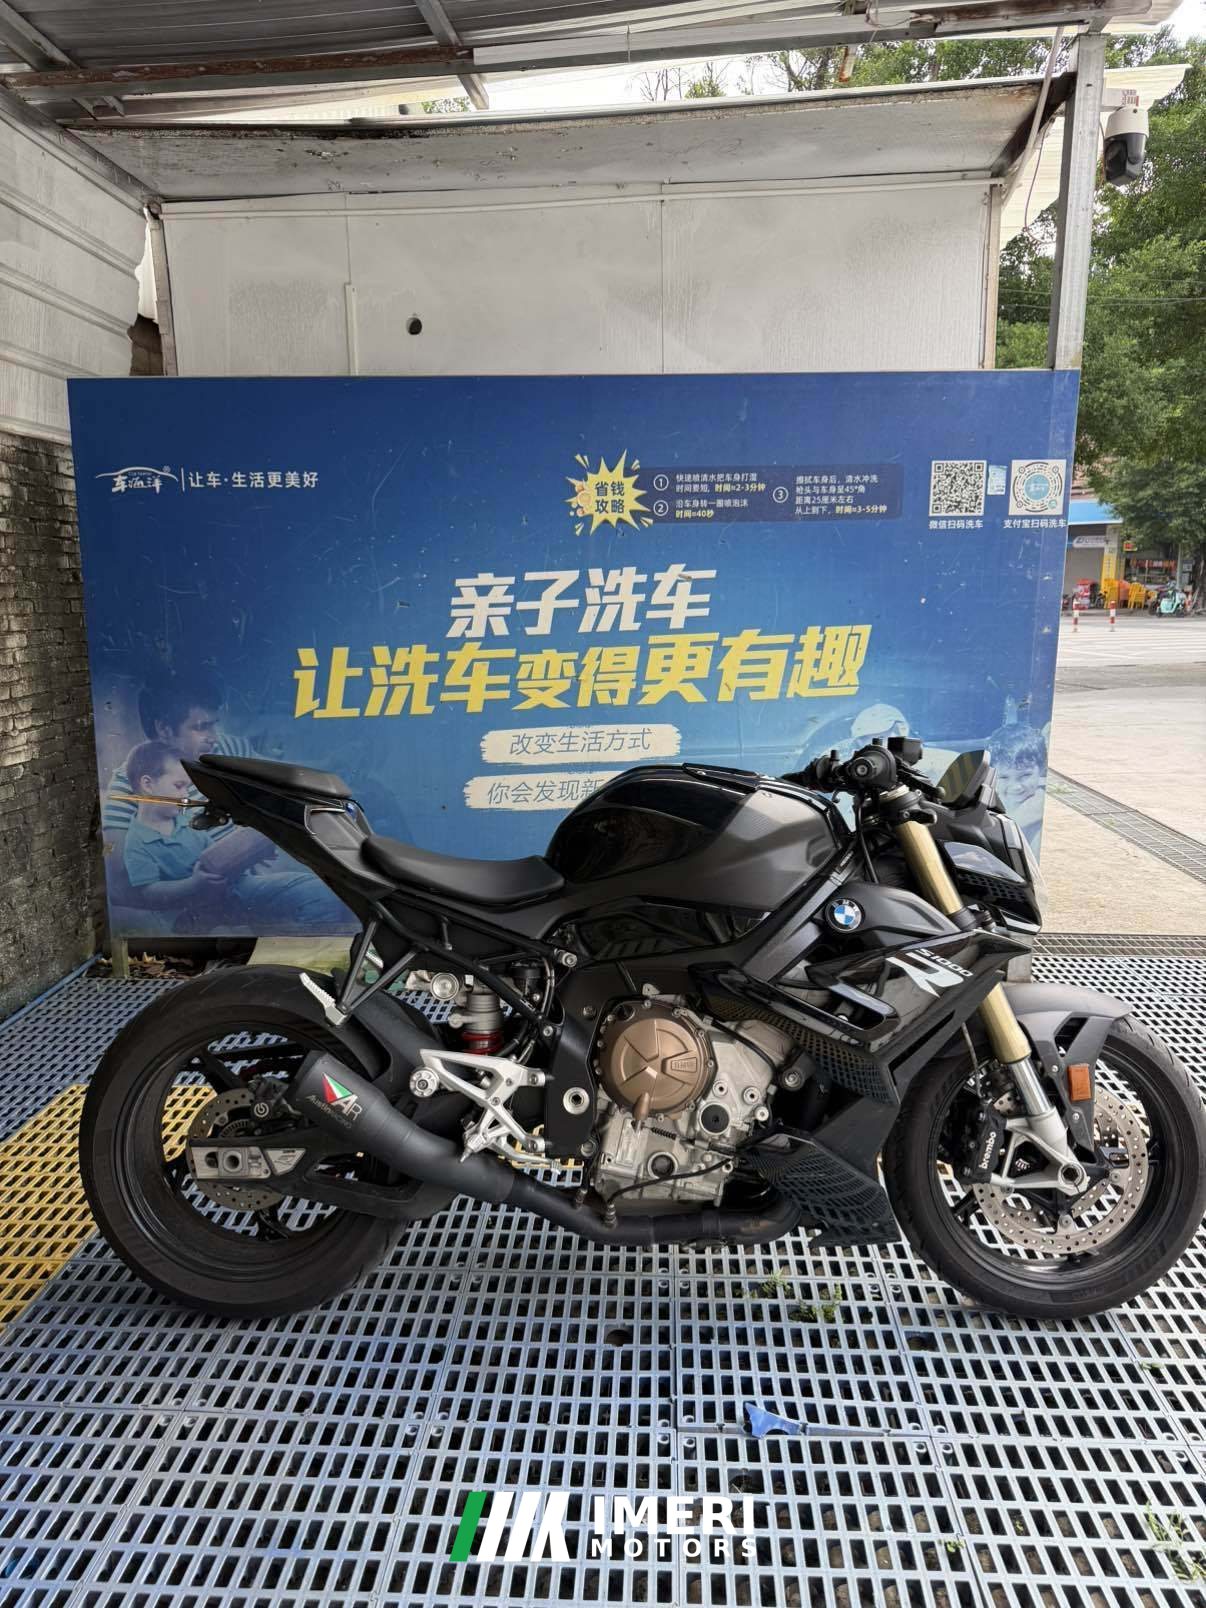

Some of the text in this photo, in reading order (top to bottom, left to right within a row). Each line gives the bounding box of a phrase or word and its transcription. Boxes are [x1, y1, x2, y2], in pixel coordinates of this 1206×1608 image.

[188, 471, 319, 488] 让车·生活更美好
[595, 481, 625, 497] 省钱
[595, 499, 625, 514] 攻略
[676, 509, 714, 519] 时间=40秒
[929, 520, 983, 529] 微信扫码洗车
[1003, 519, 1067, 529] 支付宝扫码洗车
[446, 563, 717, 638] 亲子洗车
[293, 624, 872, 719] 让洗车变得更有趣
[509, 728, 653, 755] 改变生活方式
[914, 948, 973, 977] S1000
[978, 1131, 997, 1170] brembo
